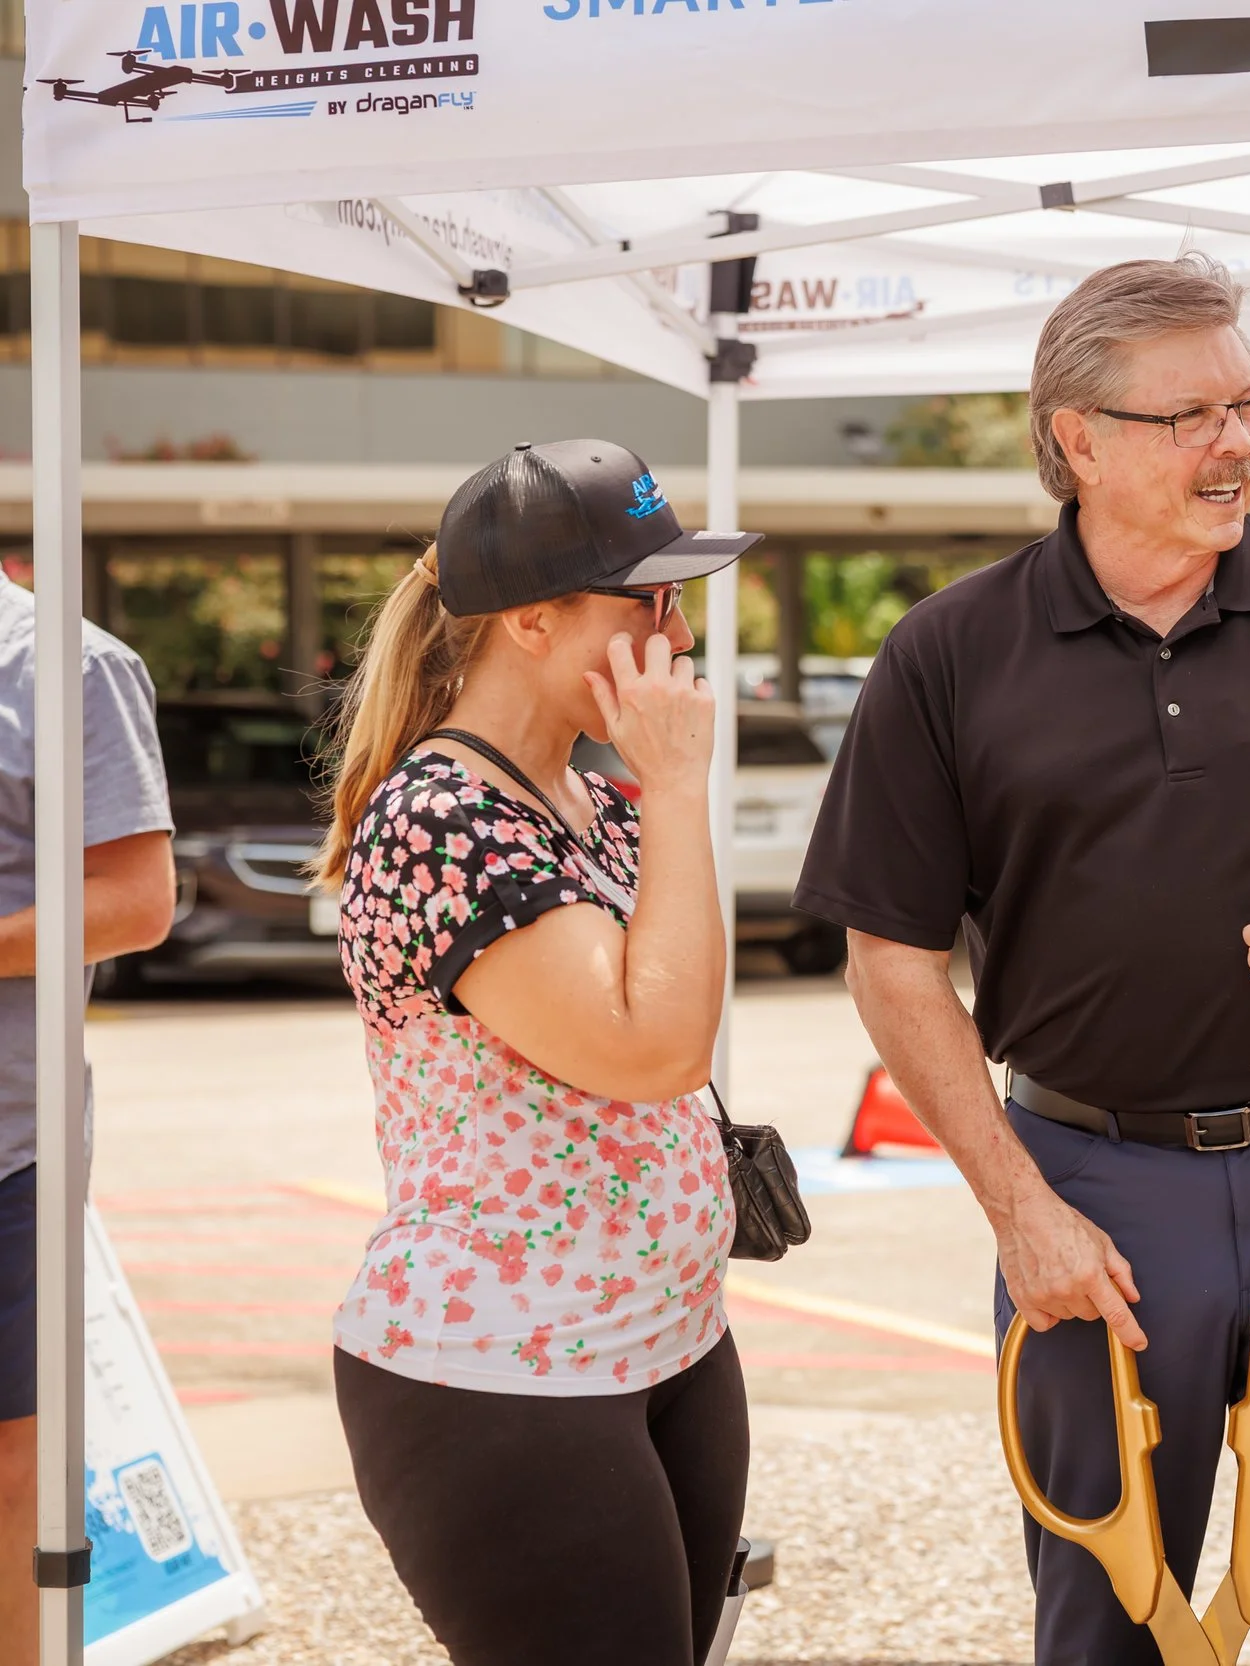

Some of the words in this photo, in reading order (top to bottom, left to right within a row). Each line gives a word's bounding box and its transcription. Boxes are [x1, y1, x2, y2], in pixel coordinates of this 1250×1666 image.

[255, 70, 348, 88] HEIGHTS
[364, 60, 475, 79] CLEANING
[327, 101, 347, 115] BY
